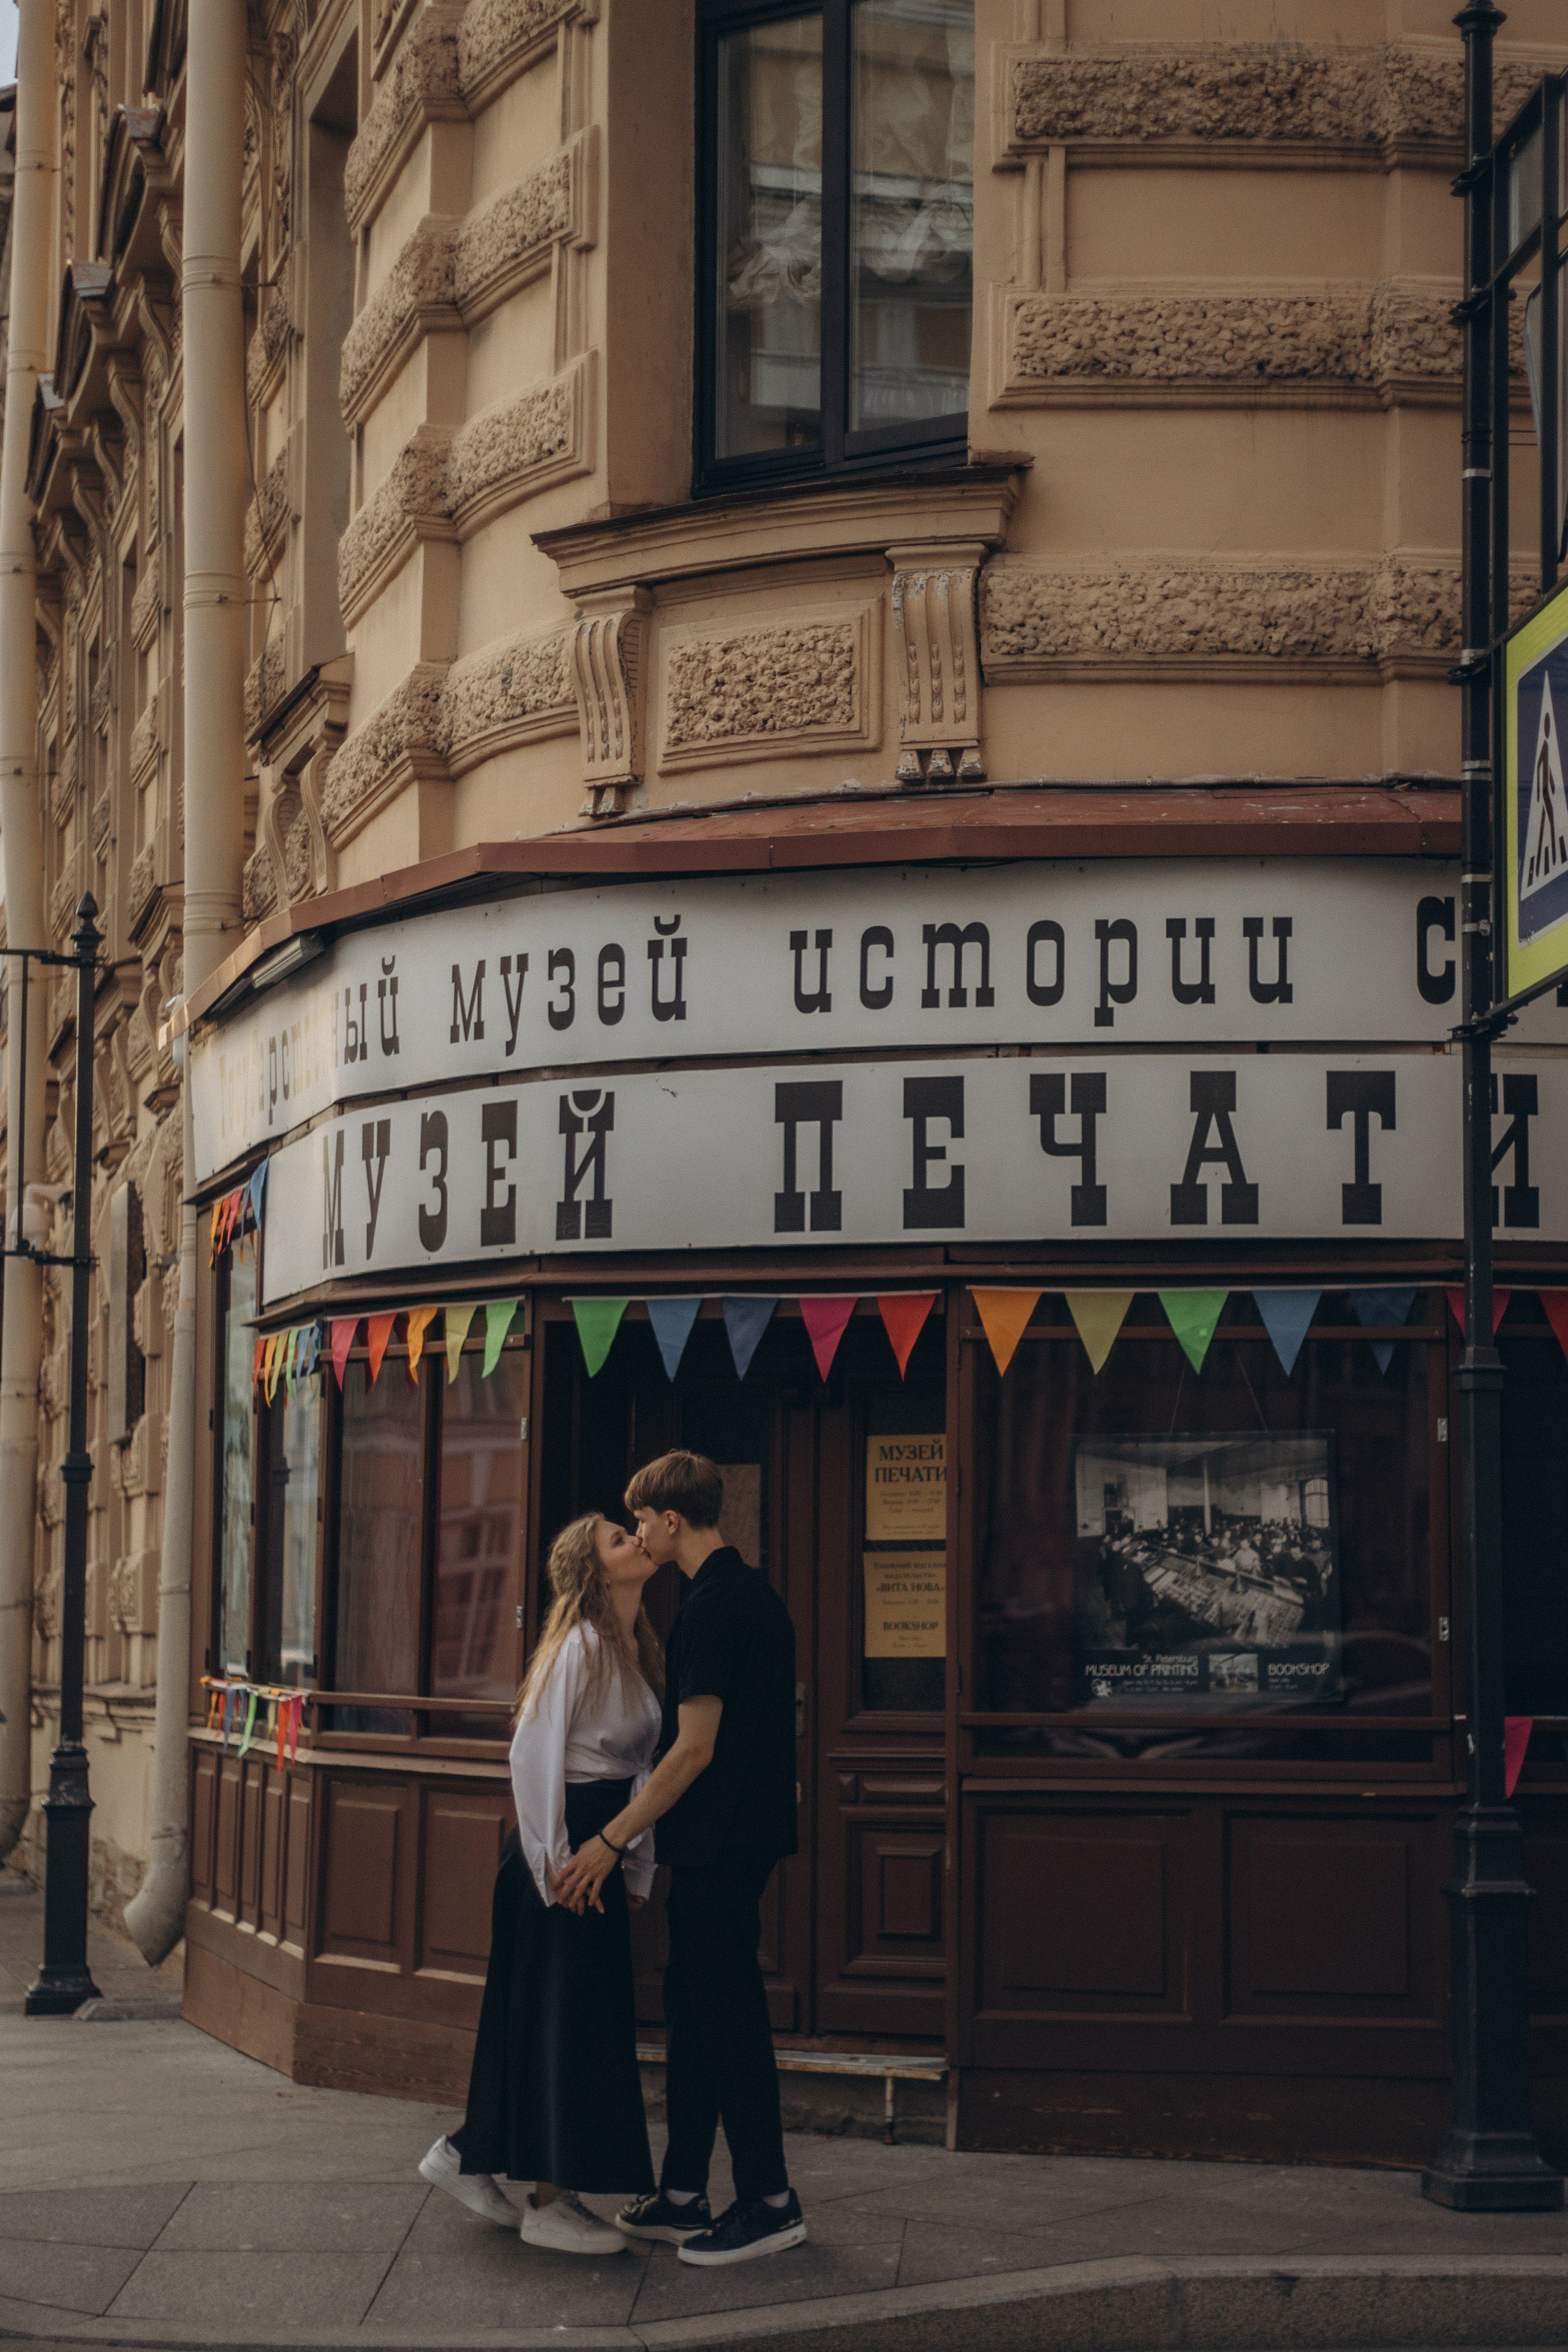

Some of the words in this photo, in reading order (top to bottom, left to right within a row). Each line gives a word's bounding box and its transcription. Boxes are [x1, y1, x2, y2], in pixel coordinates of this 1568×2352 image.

[450, 915, 687, 1055] музей
[790, 917, 1293, 1027] истории
[322, 1089, 615, 1270] МУЗЕЙ
[774, 1071, 1539, 1232] ПЕЧАТИ
[880, 1438, 943, 1461] МУЗЕЙ
[875, 1466, 946, 1483] ПЕЧАТИ
[882, 1621, 939, 1631] BOOKSHOP
[1085, 1664, 1131, 1677] MUSEUM
[1133, 1664, 1148, 1677] OF
[1150, 1664, 1199, 1677] PRINTING
[1267, 1662, 1330, 1676] BOOKSHOP
